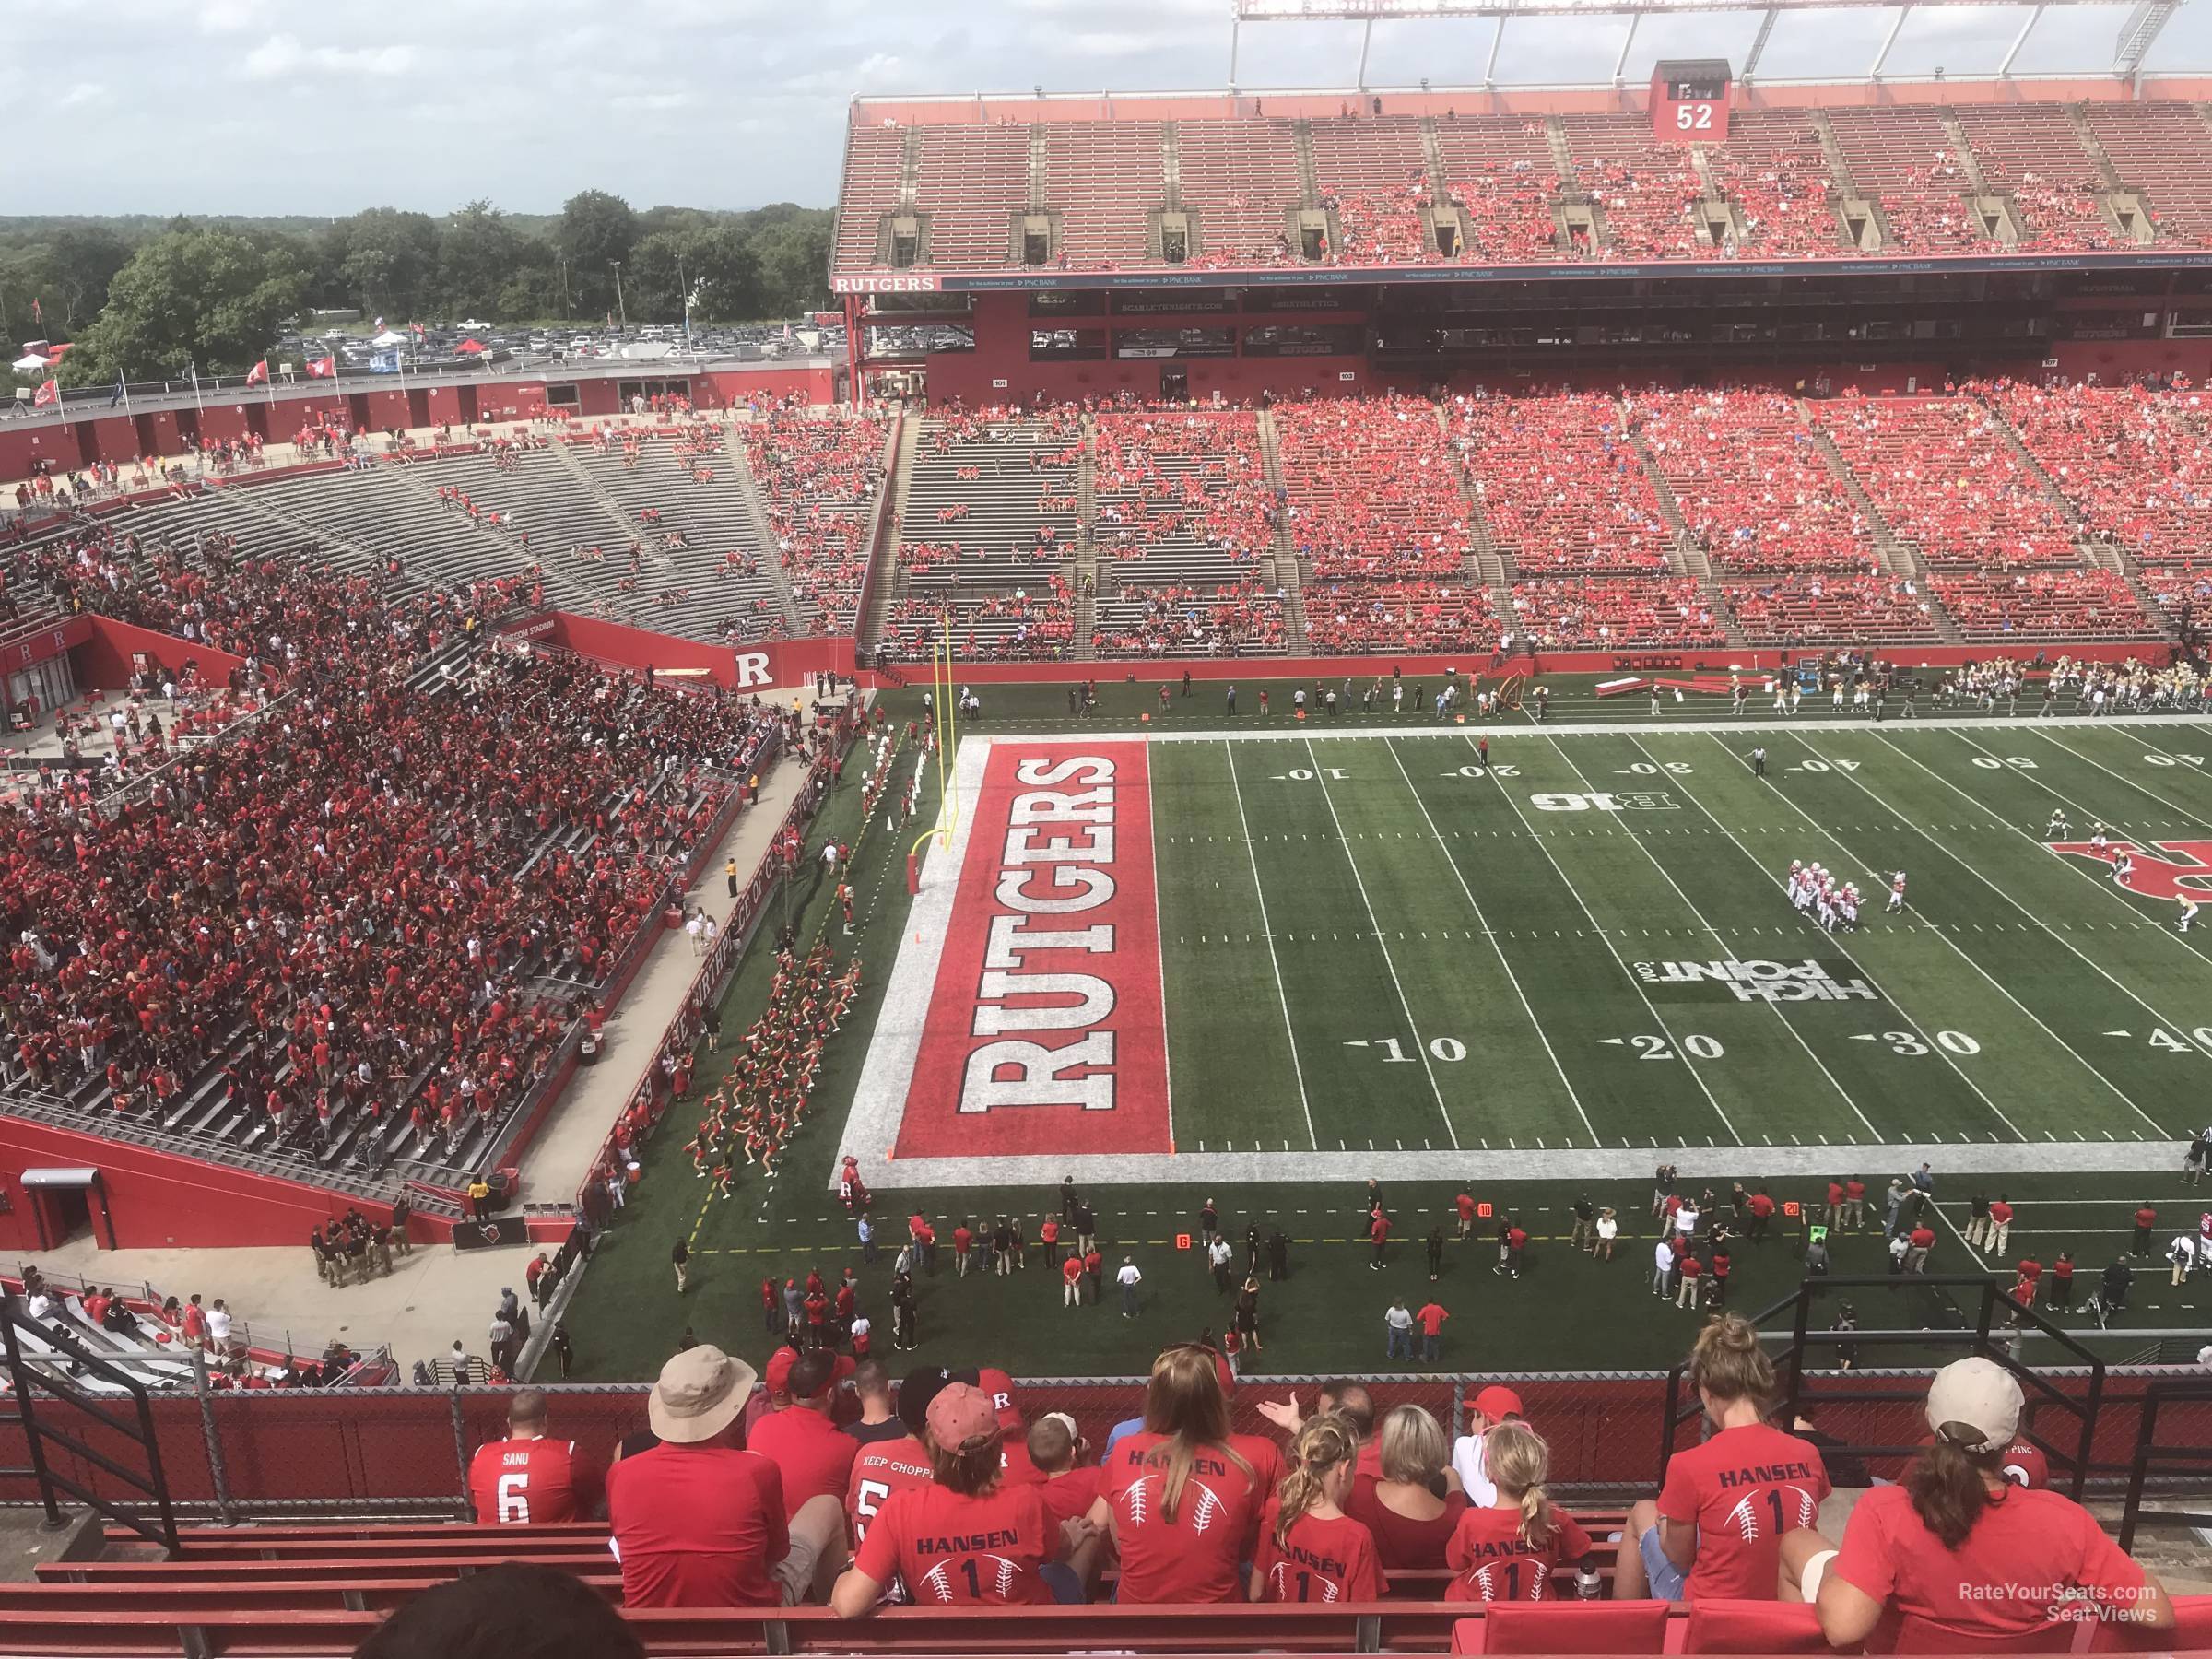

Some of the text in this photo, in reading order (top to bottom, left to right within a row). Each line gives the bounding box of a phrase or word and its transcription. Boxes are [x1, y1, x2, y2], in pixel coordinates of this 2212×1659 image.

[1677, 104, 1712, 130] 52
[836, 277, 935, 292] RUTGERS
[529, 619, 555, 635] STADIUM
[53, 630, 66, 646] R
[19, 643, 32, 661] R
[735, 652, 773, 688] R
[1628, 762, 1694, 775] 30
[1800, 759, 1862, 772] 40
[1971, 756, 2040, 770] 50
[2142, 753, 2206, 767] 40
[1288, 768, 1351, 781] 10
[1458, 764, 1522, 778] 20
[956, 756, 1117, 1113] RUTGERS
[1658, 959, 1830, 982] POINT
[1725, 979, 1878, 1001] HIGH
[1374, 1037, 1467, 1062] 10
[1630, 1034, 1724, 1060] 20
[1882, 1030, 1982, 1055] 30
[840, 1181, 852, 1197] R
[1481, 1205, 1490, 1216] 10
[1787, 1204, 1798, 1215] 20
[1180, 1236, 1188, 1247] G
[993, 1393, 1010, 1409] R
[2006, 1445, 2032, 1454] PING
[503, 1453, 529, 1466] SANU
[864, 1455, 888, 1467] KEEP
[1128, 1450, 1226, 1477] HANEN
[1719, 1462, 1811, 1488] HANSEN
[498, 1474, 530, 1524] 6
[1767, 1489, 1784, 1535] 1
[916, 1528, 1018, 1555] HANSEN
[961, 1559, 981, 1598] 1
[1296, 1571, 1310, 1603] 1
[1504, 1563, 1519, 1601] 1
